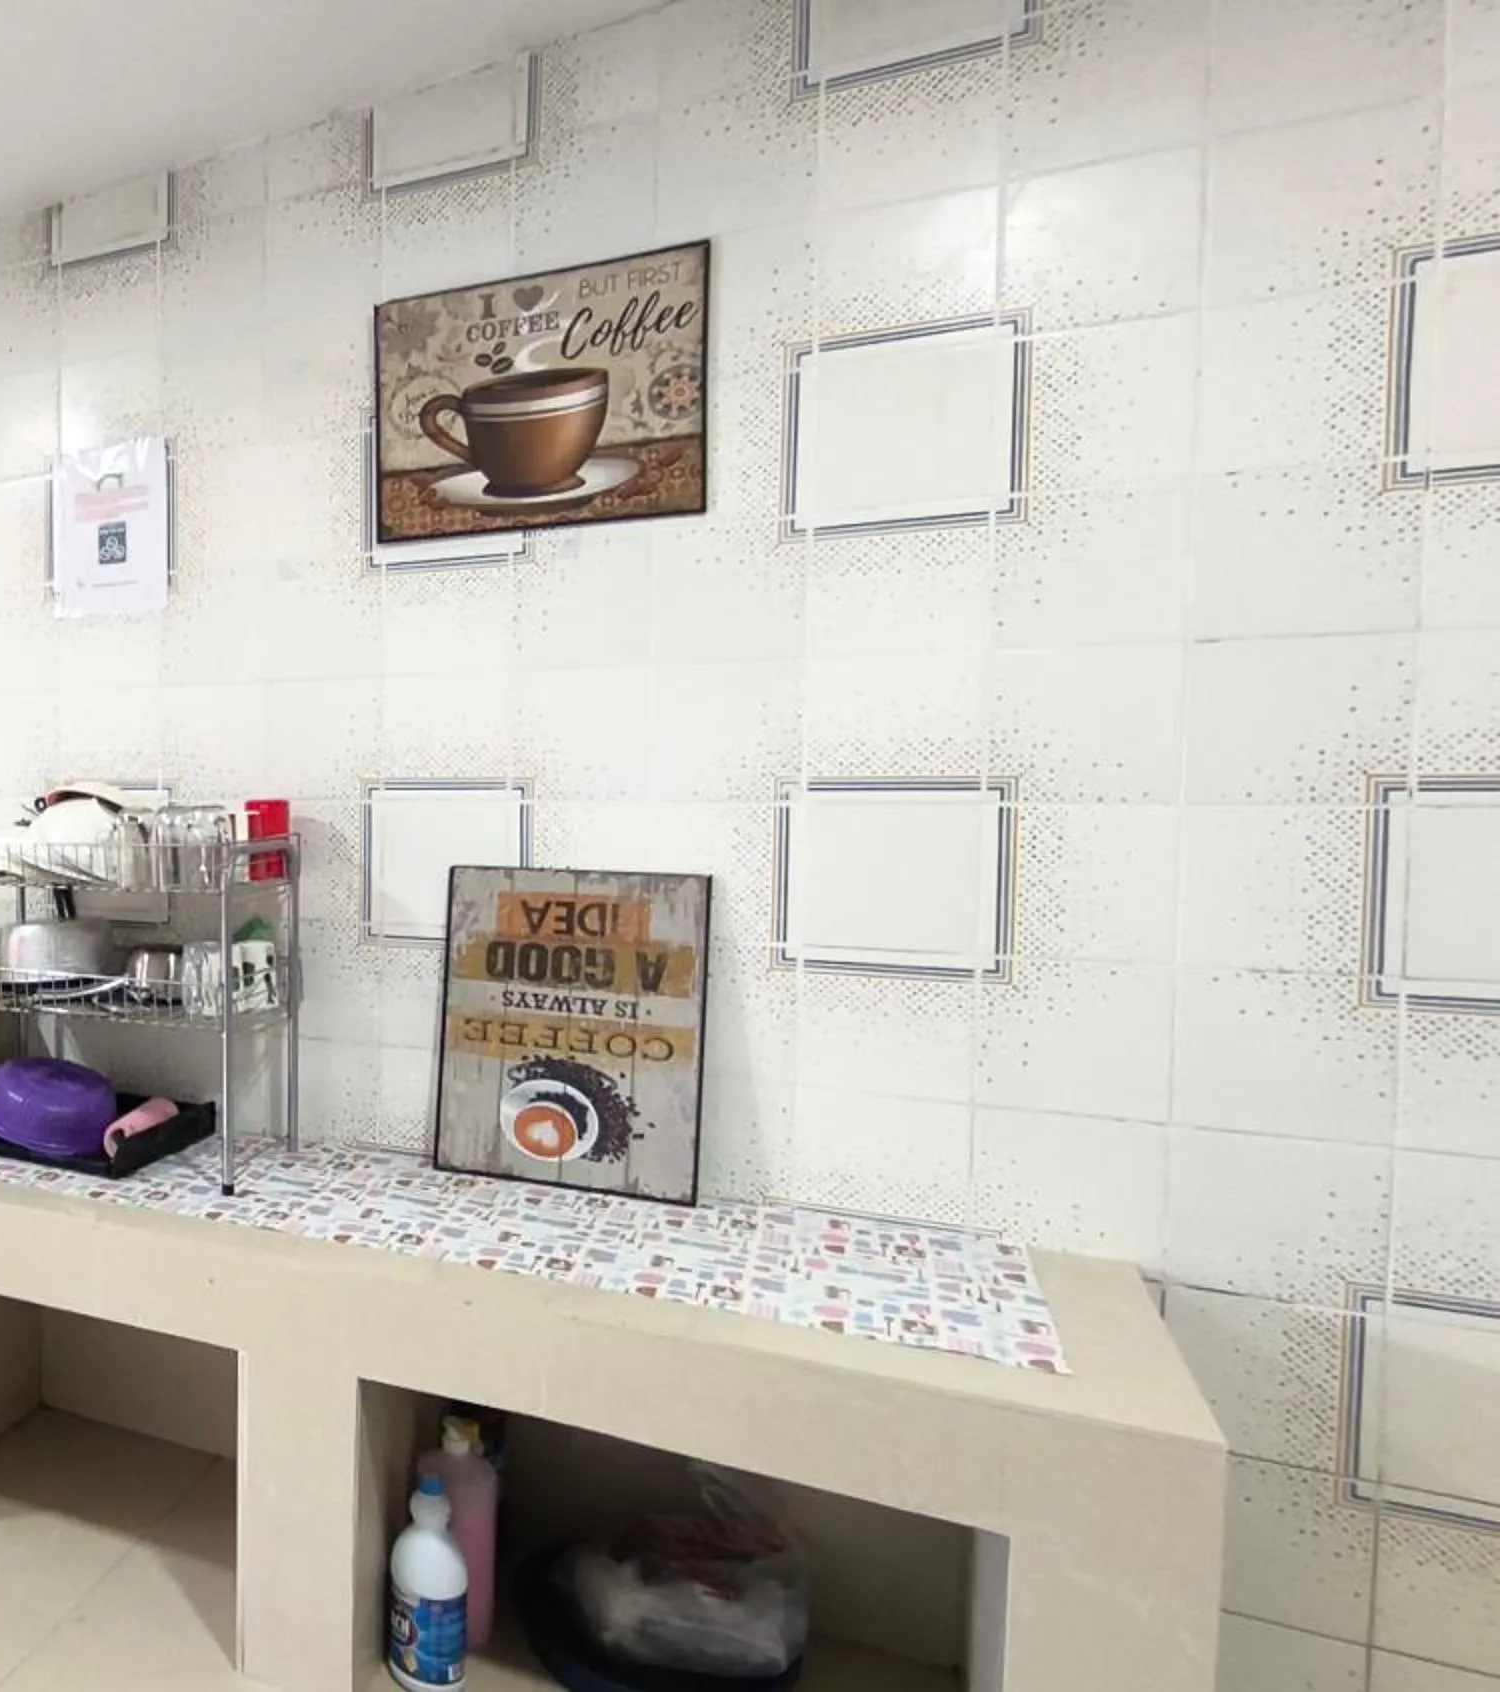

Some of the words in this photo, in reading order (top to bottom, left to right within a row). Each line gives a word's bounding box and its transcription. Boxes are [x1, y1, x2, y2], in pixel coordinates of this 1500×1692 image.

[579, 275, 617, 298] BUT
[626, 261, 681, 290] FIRST
[478, 293, 496, 320] I
[561, 290, 698, 360] Coffee
[466, 311, 560, 342] COFFEE
[522, 900, 621, 937] IDEA
[486, 942, 614, 987] GOOD
[637, 952, 668, 992] A
[502, 990, 608, 1016] ALWAYS
[614, 1001, 639, 1019] IS
[464, 1018, 674, 1062] COFFEE
